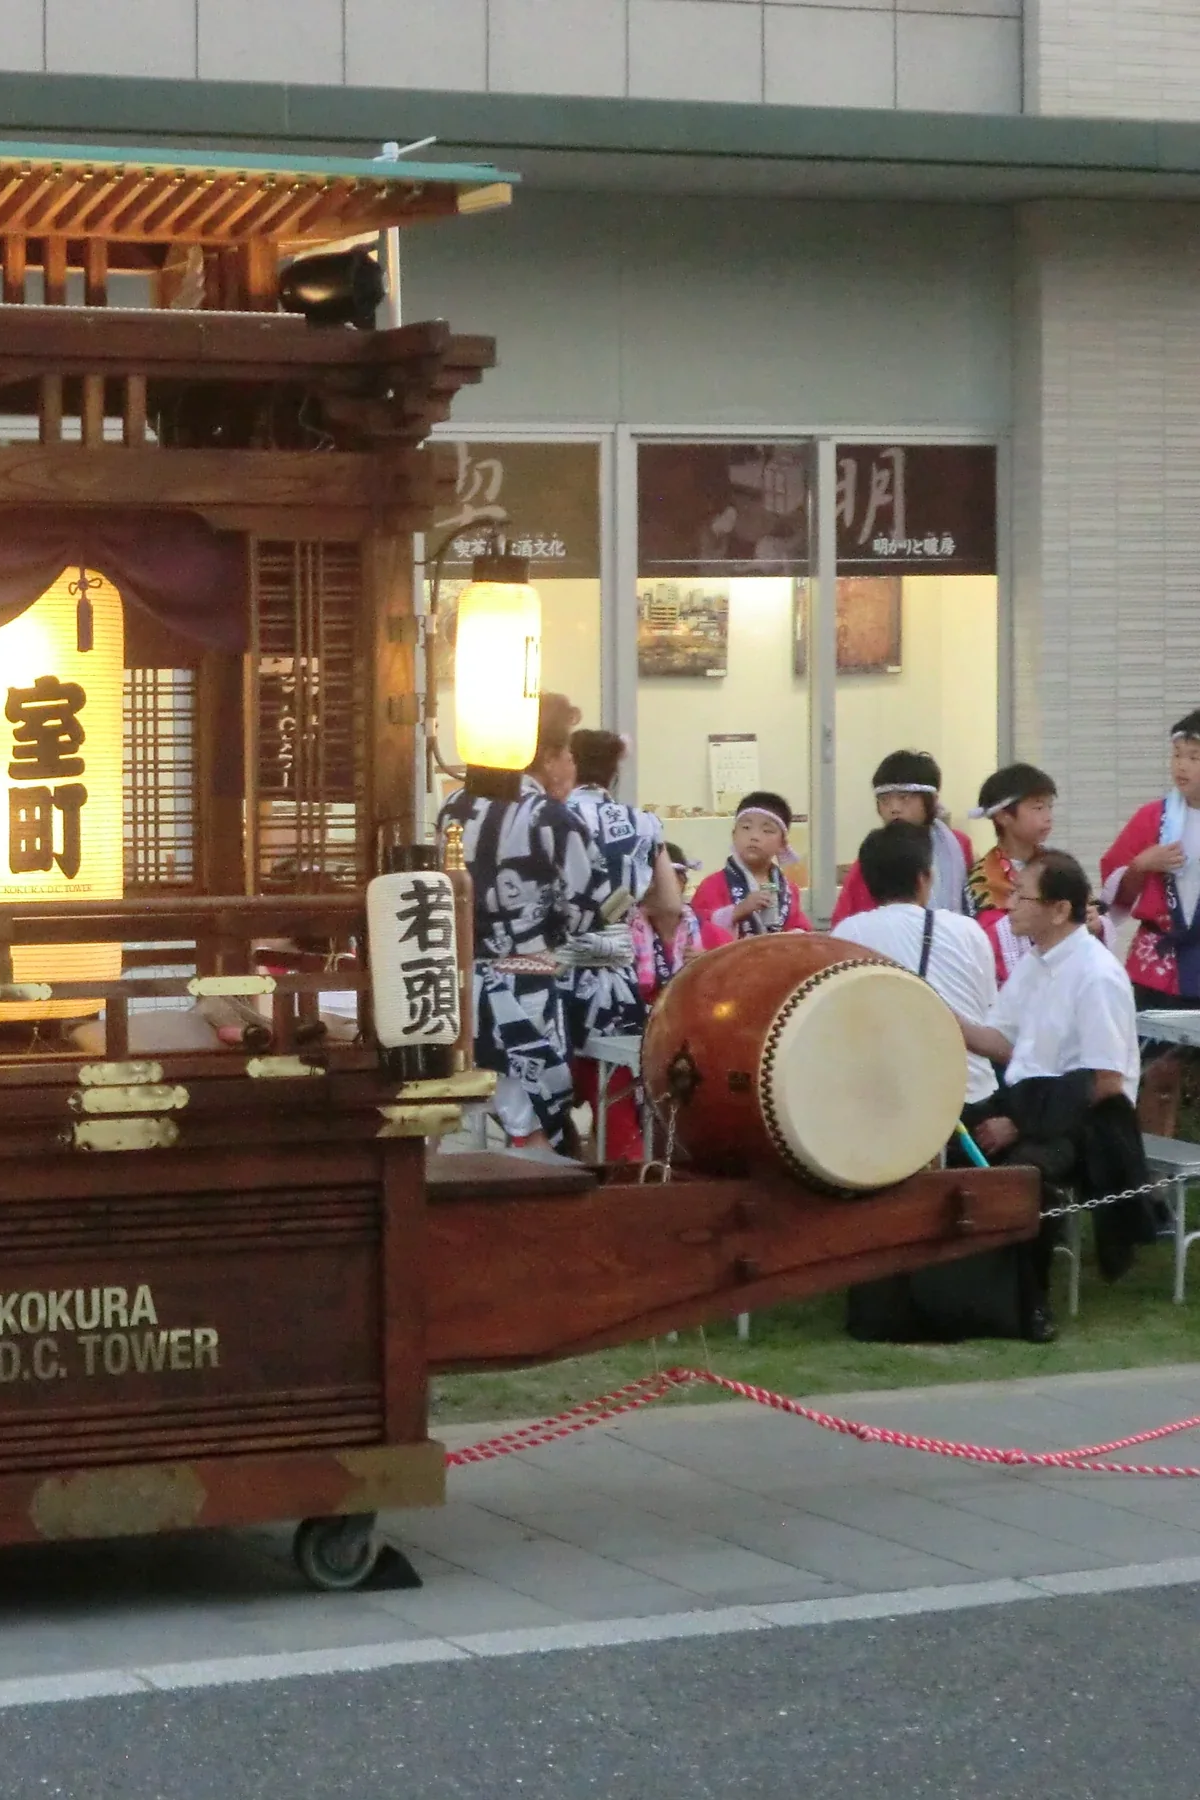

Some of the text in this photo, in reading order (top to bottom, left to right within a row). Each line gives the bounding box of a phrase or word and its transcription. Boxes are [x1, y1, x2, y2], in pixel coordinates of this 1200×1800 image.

[873, 537, 956, 555] 明かりと暖房
[4, 675, 88, 880] 室町
[4, 886, 45, 894] KOKURA
[65, 884, 93, 893] TOWER
[396, 880, 458, 1035] 若頭
[78, 1328, 220, 1376] TOWER
